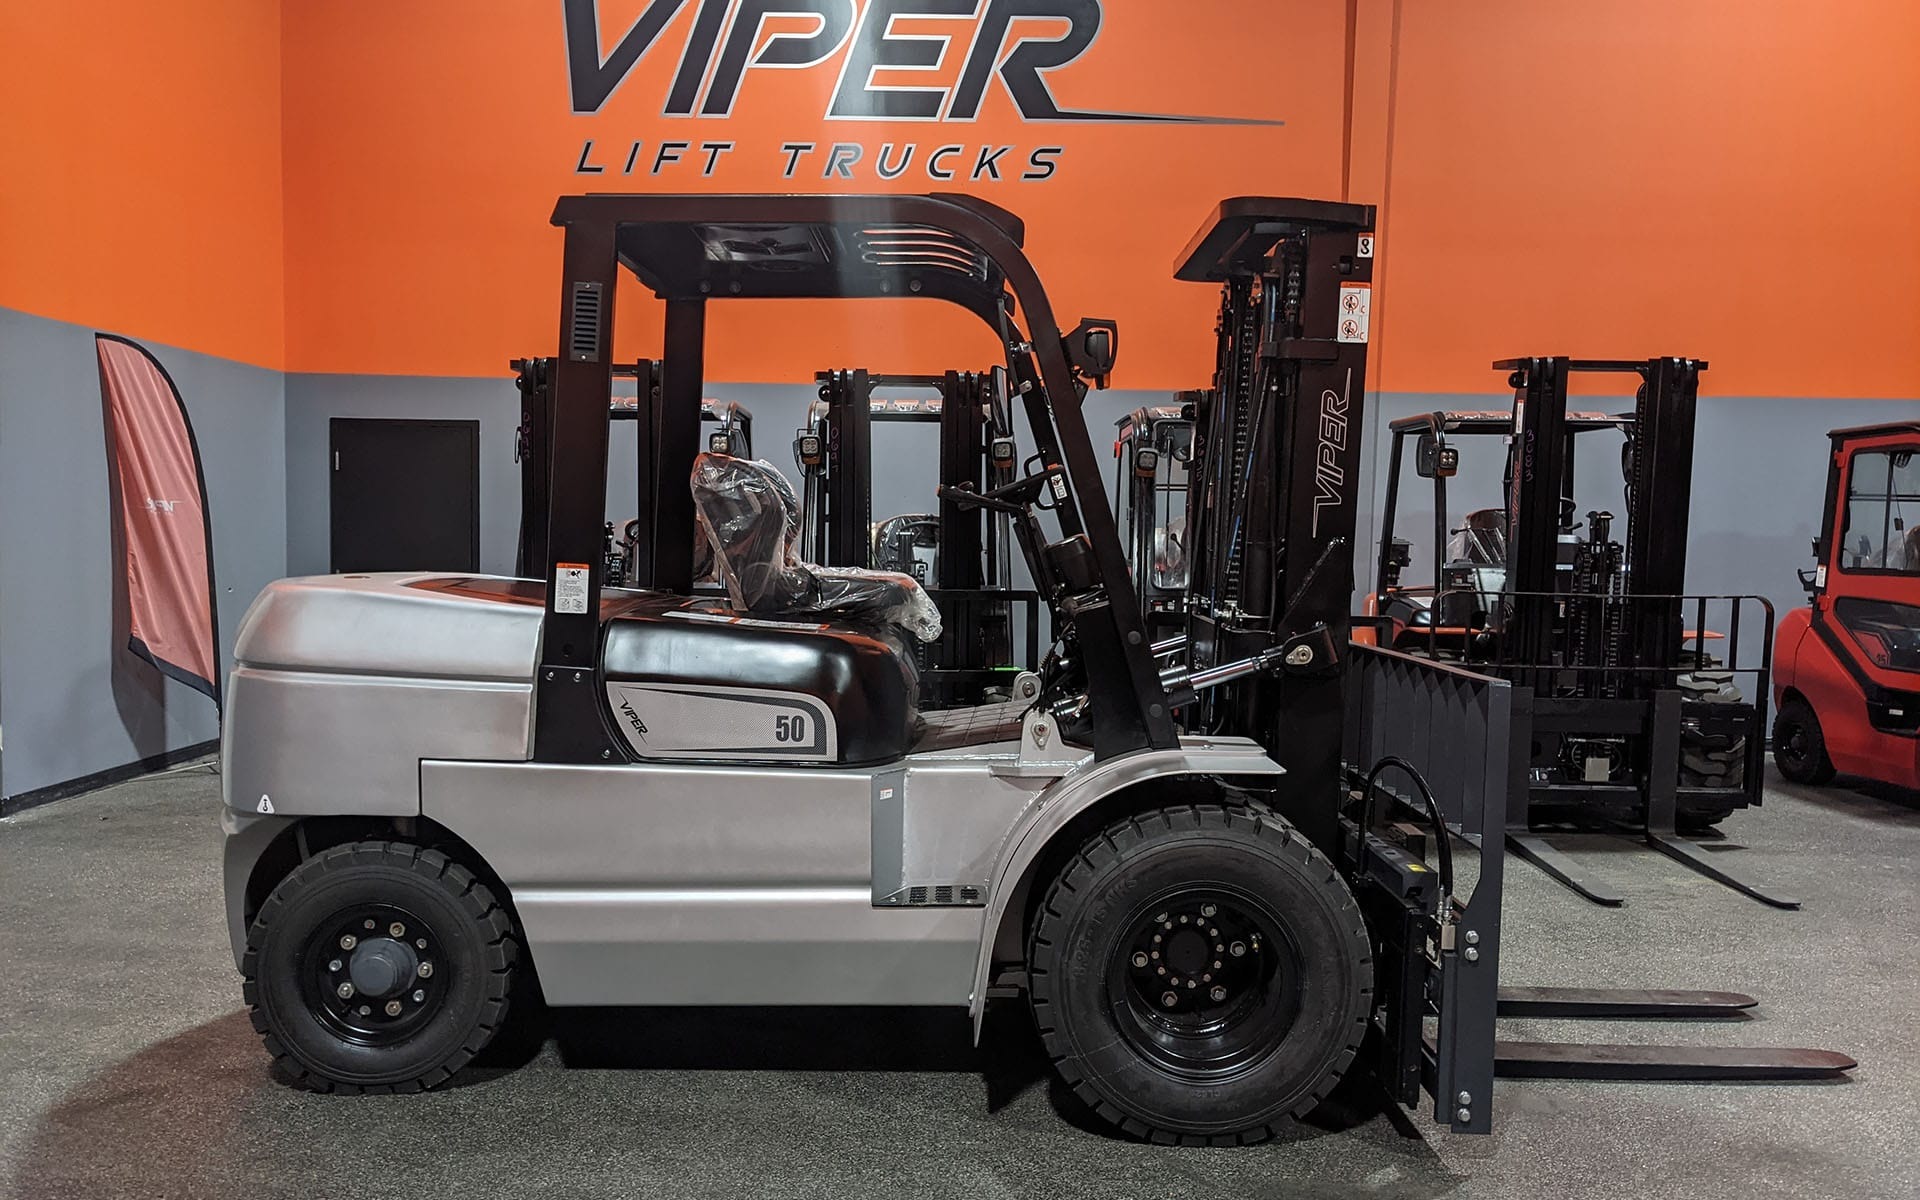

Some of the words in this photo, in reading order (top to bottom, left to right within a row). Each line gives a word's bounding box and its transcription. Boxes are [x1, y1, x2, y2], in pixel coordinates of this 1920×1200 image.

[561, 0, 1285, 124] VIPER
[576, 140, 735, 176] LIFT
[782, 141, 1067, 180] TRUCKS
[1313, 368, 1351, 538] VIPER
[618, 688, 648, 745] VIPER
[776, 715, 805, 742] 50
